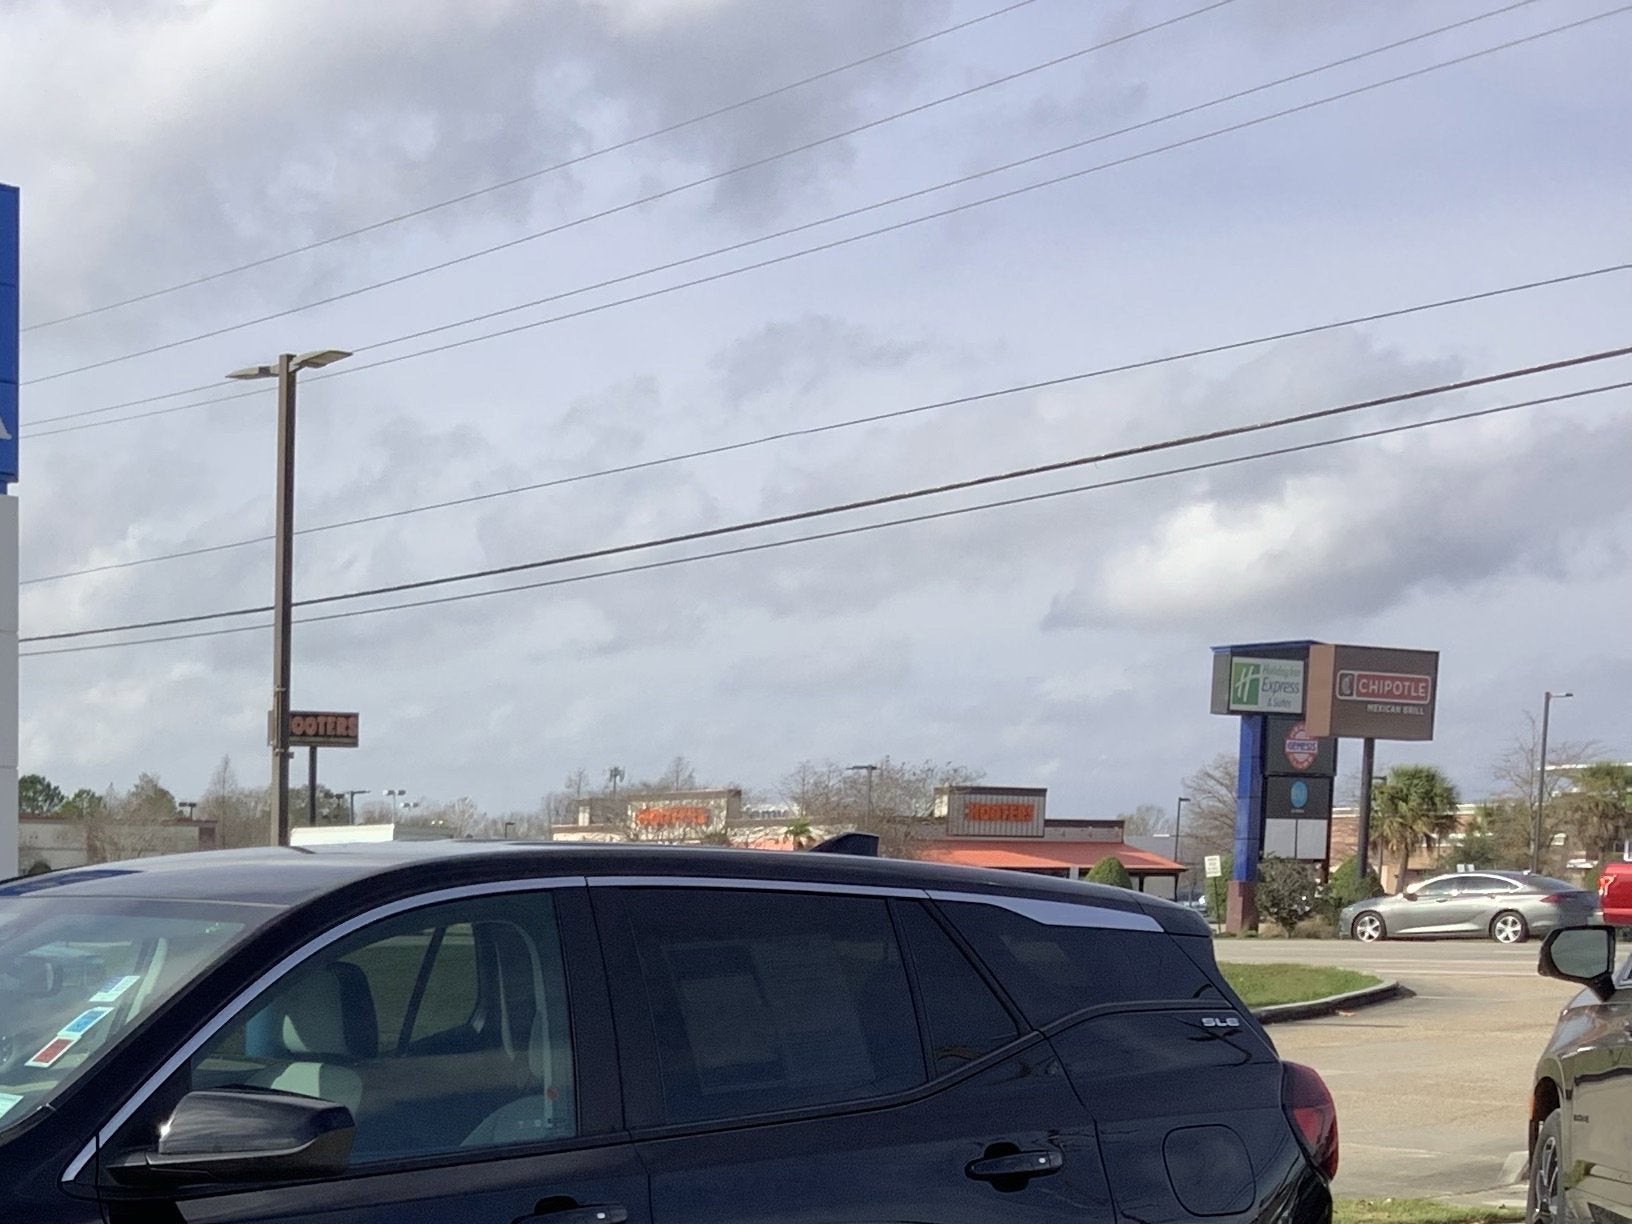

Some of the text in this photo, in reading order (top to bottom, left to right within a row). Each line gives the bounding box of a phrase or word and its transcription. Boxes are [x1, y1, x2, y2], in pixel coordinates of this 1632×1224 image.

[1262, 677, 1300, 696] Express
[1358, 678, 1426, 697] CHIPOTLE
[1367, 704, 1402, 714] MEXICAN
[289, 715, 357, 737] OOTERS
